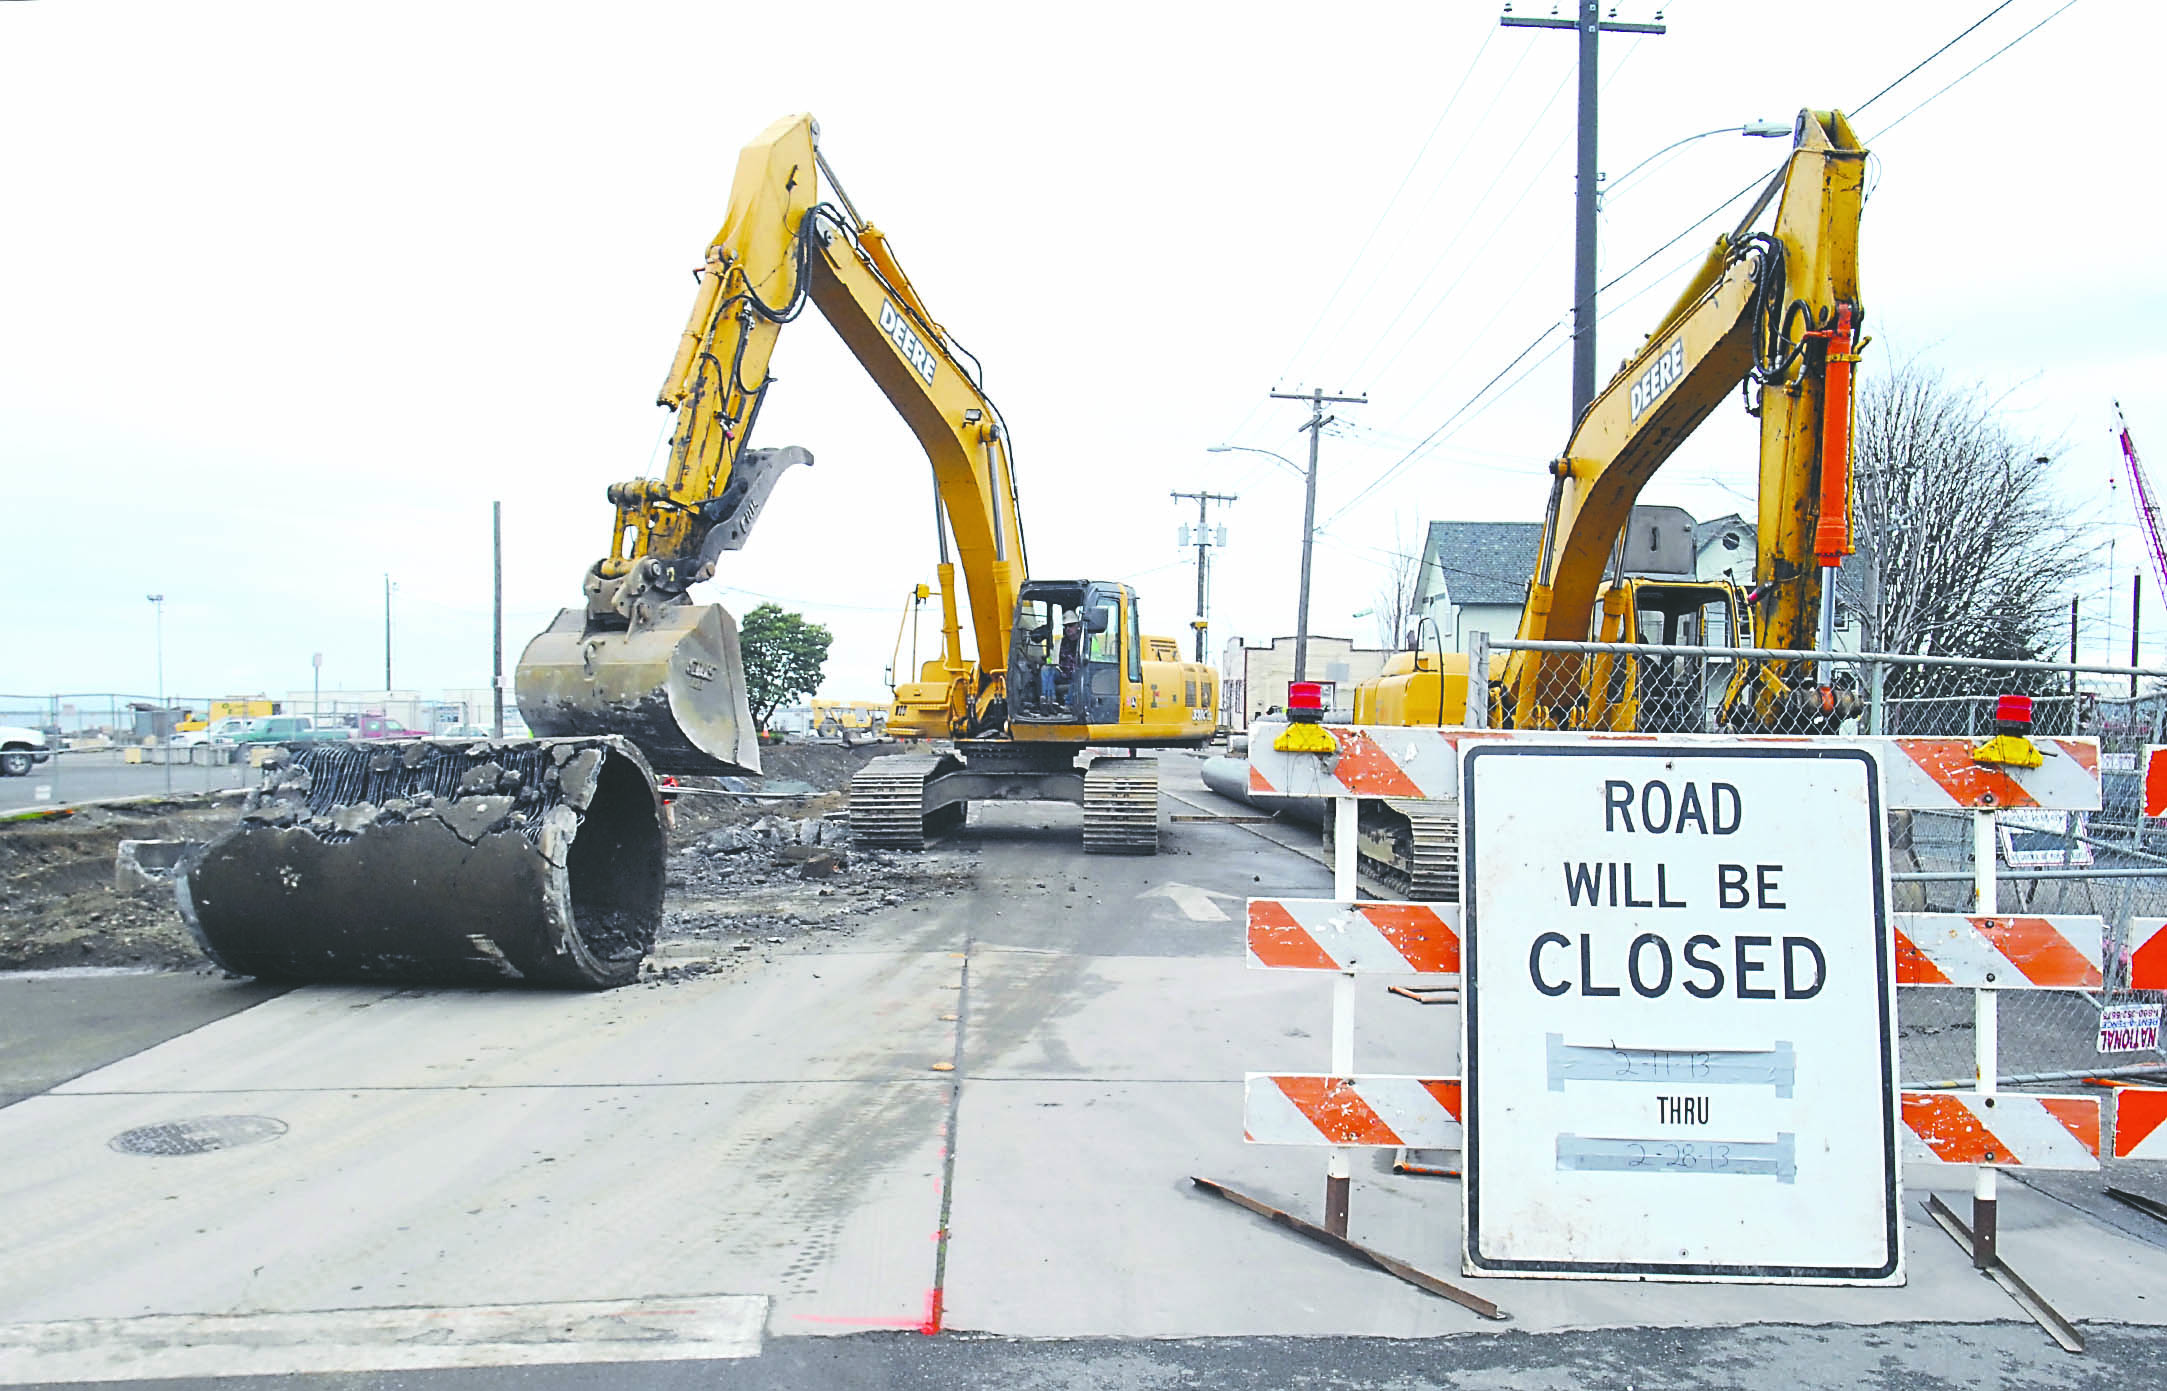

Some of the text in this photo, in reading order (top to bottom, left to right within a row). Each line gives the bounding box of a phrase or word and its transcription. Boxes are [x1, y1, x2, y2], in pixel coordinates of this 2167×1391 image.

[879, 298, 936, 387] DEERE
[1630, 337, 1683, 424] DEERE
[1605, 779, 1742, 835] ROAD
[1564, 861, 1787, 909] WILL BE
[1529, 931, 1827, 1000] CLOSED
[2100, 1026, 2157, 1051] NATIONAL
[1614, 1050, 1711, 1078] 2-11-13
[1656, 1095, 1710, 1125] THRU
[1626, 1143, 1731, 1169] 2-28-13
